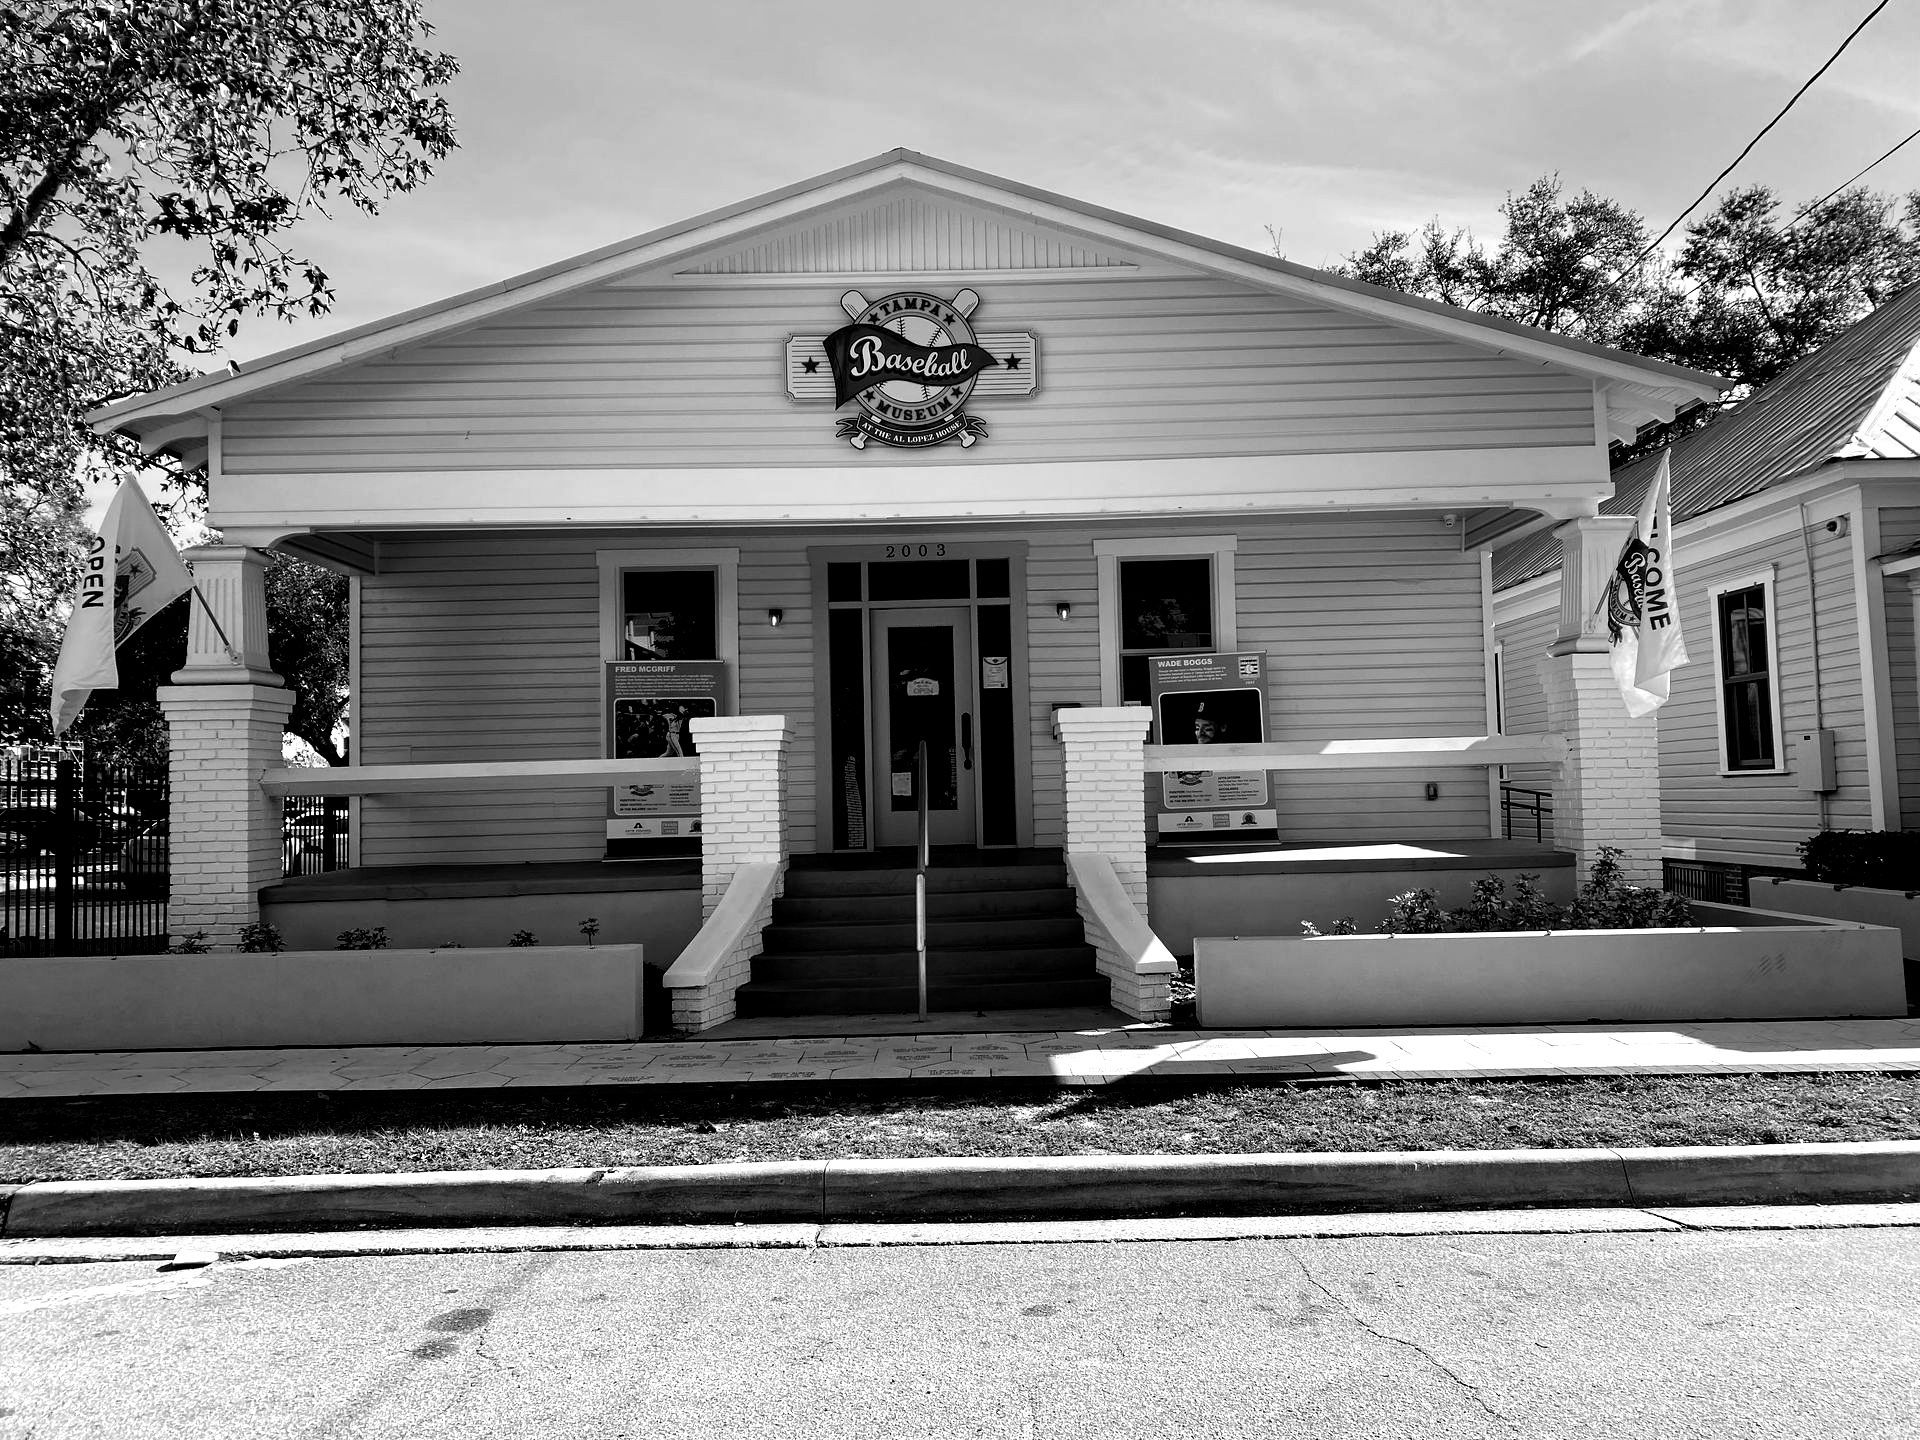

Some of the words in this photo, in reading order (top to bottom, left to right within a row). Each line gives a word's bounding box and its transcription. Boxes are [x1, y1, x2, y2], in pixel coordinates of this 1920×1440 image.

[879, 297, 942, 317] TAMPA
[849, 335, 972, 377] Baseball
[875, 396, 953, 421] MUSEUM
[862, 422, 874, 431] AT
[874, 428, 892, 440] THE
[893, 435, 905, 443] AL
[907, 433, 935, 443] LOPEZ
[935, 420, 962, 439] HOUSE
[886, 543, 945, 559] 2003
[82, 536, 105, 608] OPEN
[1645, 510, 1671, 631] COME
[638, 665, 676, 673] MCGRIFF
[1157, 660, 1182, 668] WADE
[1183, 658, 1213, 667] BOGGS
